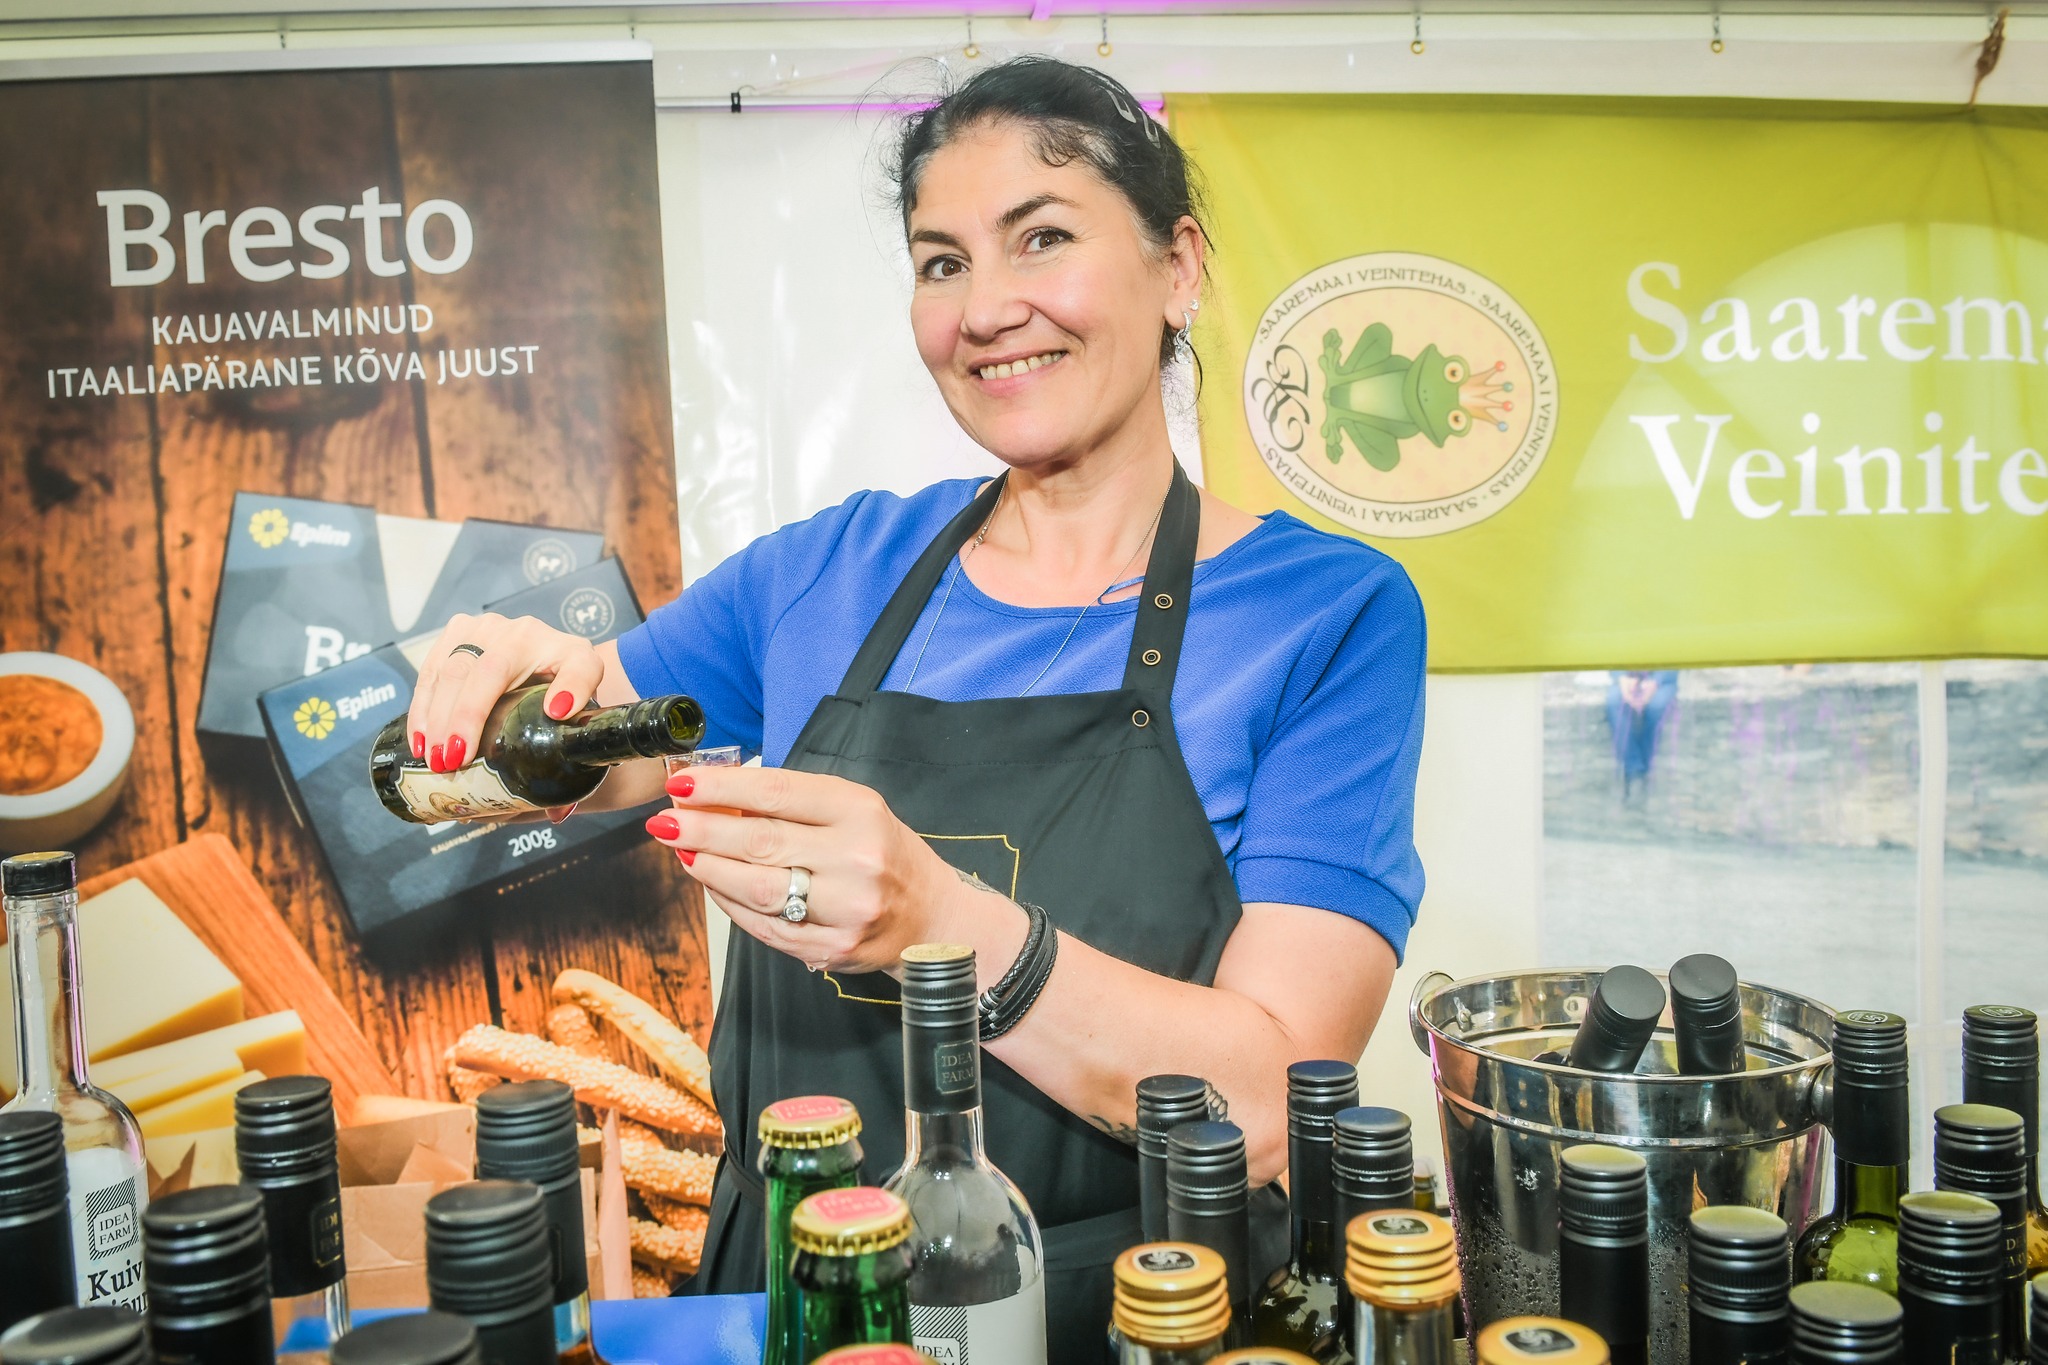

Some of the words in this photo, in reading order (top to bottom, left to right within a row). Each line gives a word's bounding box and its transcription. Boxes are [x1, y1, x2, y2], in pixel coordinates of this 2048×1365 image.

[96, 186, 473, 287] Bresto
[1260, 276, 1344, 339] SAAREMAA
[1357, 267, 1466, 295] VEINITEHAS
[1626, 261, 2048, 365] Saarem
[152, 304, 433, 345] KAUAVALMINUD
[1479, 294, 1549, 384] SAAREMAA
[48, 355, 322, 398] ITAALIAPÄRANE
[334, 348, 427, 384] KÕVA
[437, 345, 539, 385] JUUST
[1489, 403, 1551, 495] VEINITEHAS
[1628, 411, 2048, 519] Veinite
[1265, 448, 1357, 519] VEINITEHAS
[1372, 497, 1478, 523] SAAREMAA
[289, 521, 352, 548] Epiim
[335, 683, 397, 721] Epiim
[508, 827, 557, 858] 200g
[941, 1051, 973, 1068] IDEA
[942, 1066, 974, 1084] FARM
[99, 1212, 130, 1232] IDEA
[99, 1225, 131, 1246] FARM
[87, 1259, 143, 1302] Kuiv
[917, 1345, 954, 1358] IDEA
